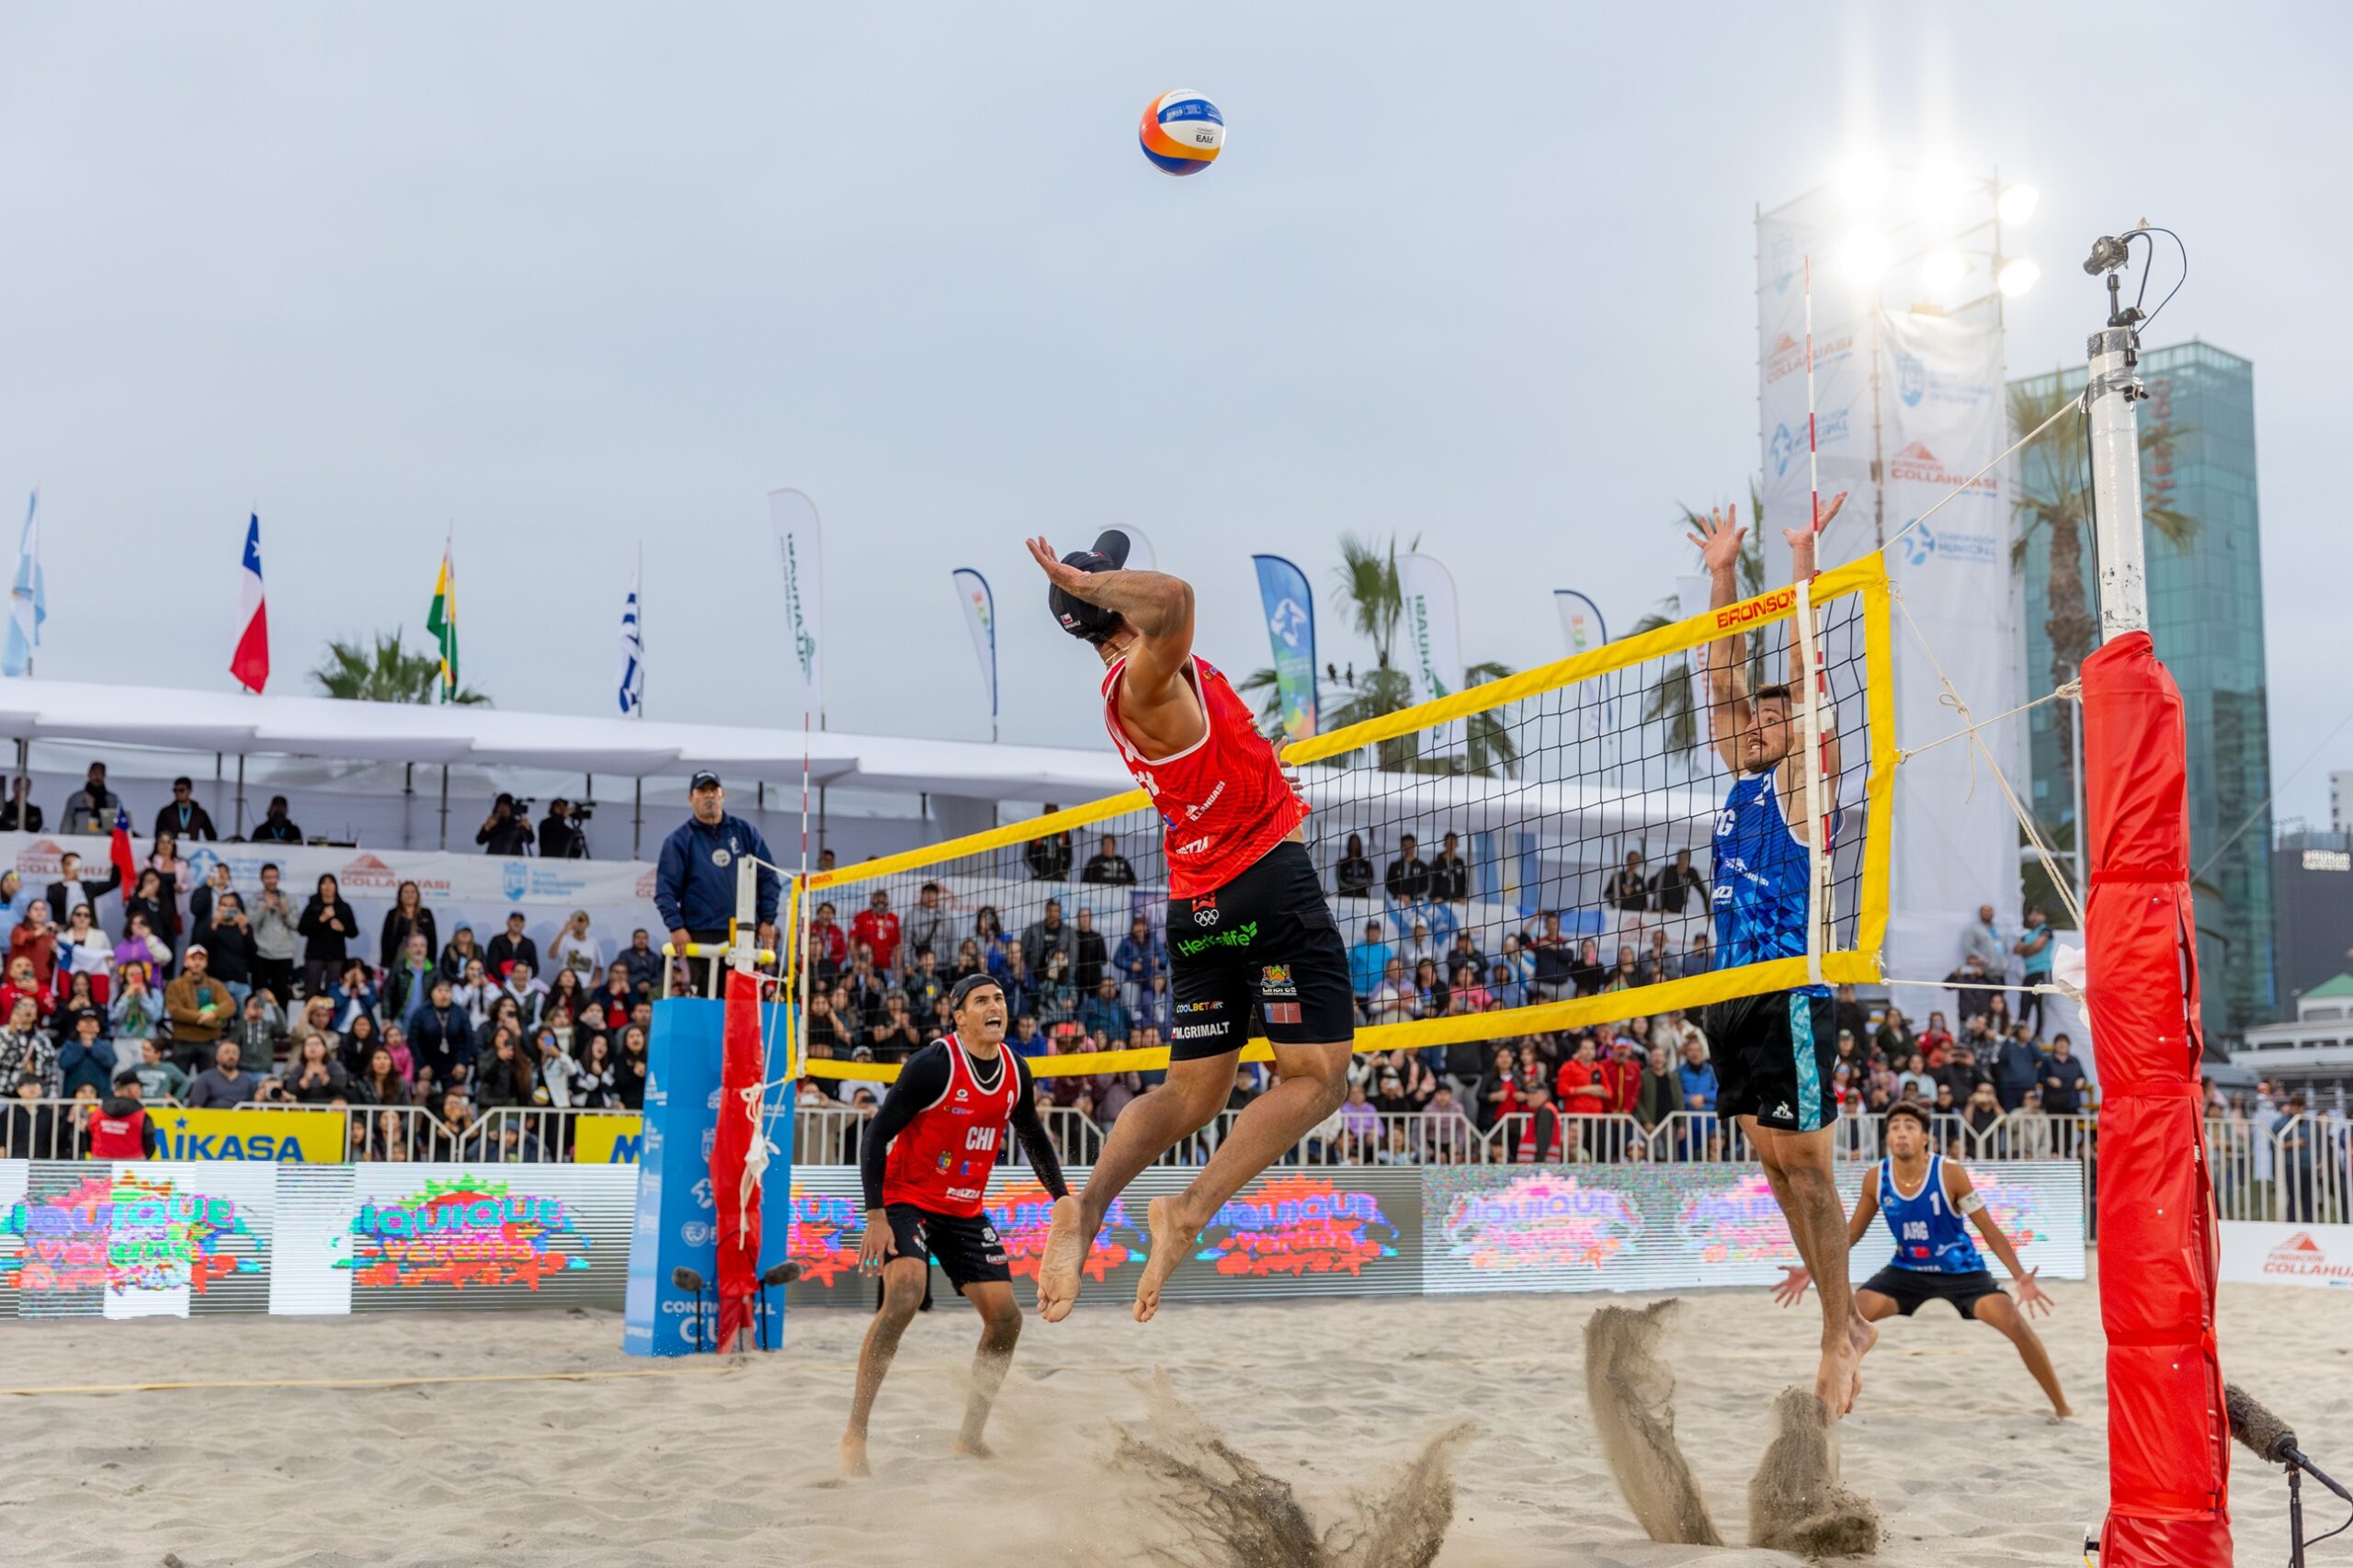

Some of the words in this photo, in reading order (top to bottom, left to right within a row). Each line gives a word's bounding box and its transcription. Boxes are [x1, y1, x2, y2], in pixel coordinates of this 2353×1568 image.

[1176, 1021, 1230, 1040] M.GRIMALT
[965, 1126, 996, 1151] CHI
[1929, 1191, 1941, 1216] 1
[1903, 1221, 1929, 1241] ARG
[2264, 1262, 2353, 1278] COLLAHU
